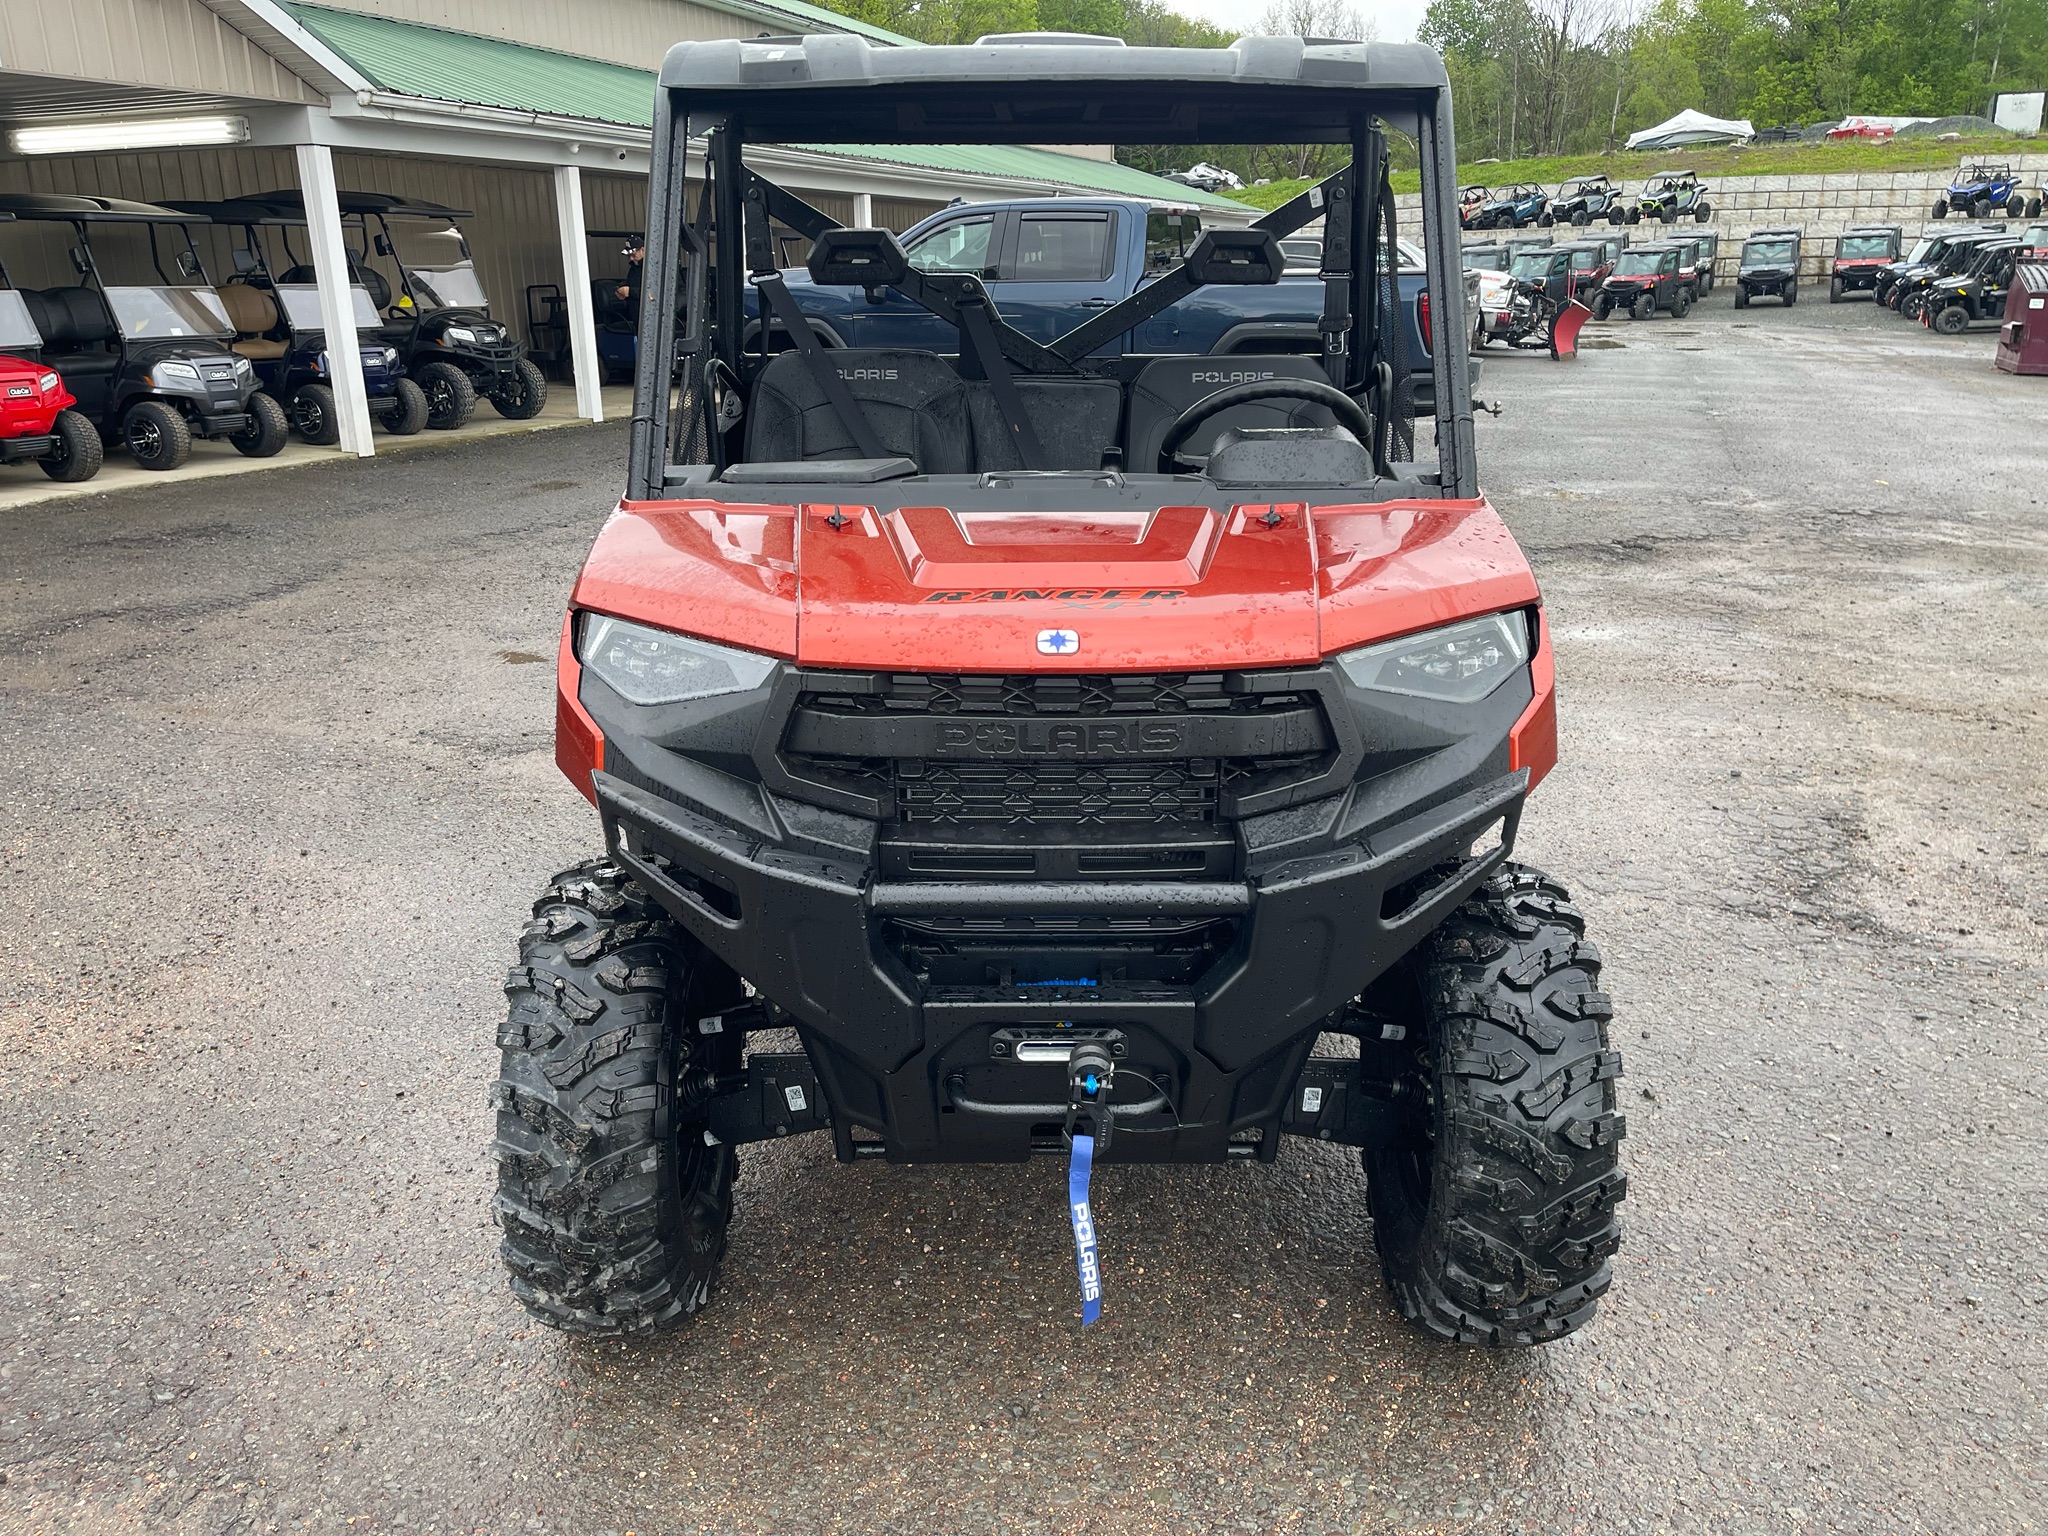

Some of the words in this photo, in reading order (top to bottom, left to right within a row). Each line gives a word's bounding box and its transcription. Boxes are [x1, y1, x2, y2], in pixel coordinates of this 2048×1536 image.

[836, 369, 898, 380] LARIS
[1192, 371, 1274, 383] POLARIS
[920, 589, 1188, 602] RANGER
[1050, 601, 1153, 610] XP
[936, 722, 1181, 754] POLARIS
[1073, 1202, 1099, 1302] POLARIS
